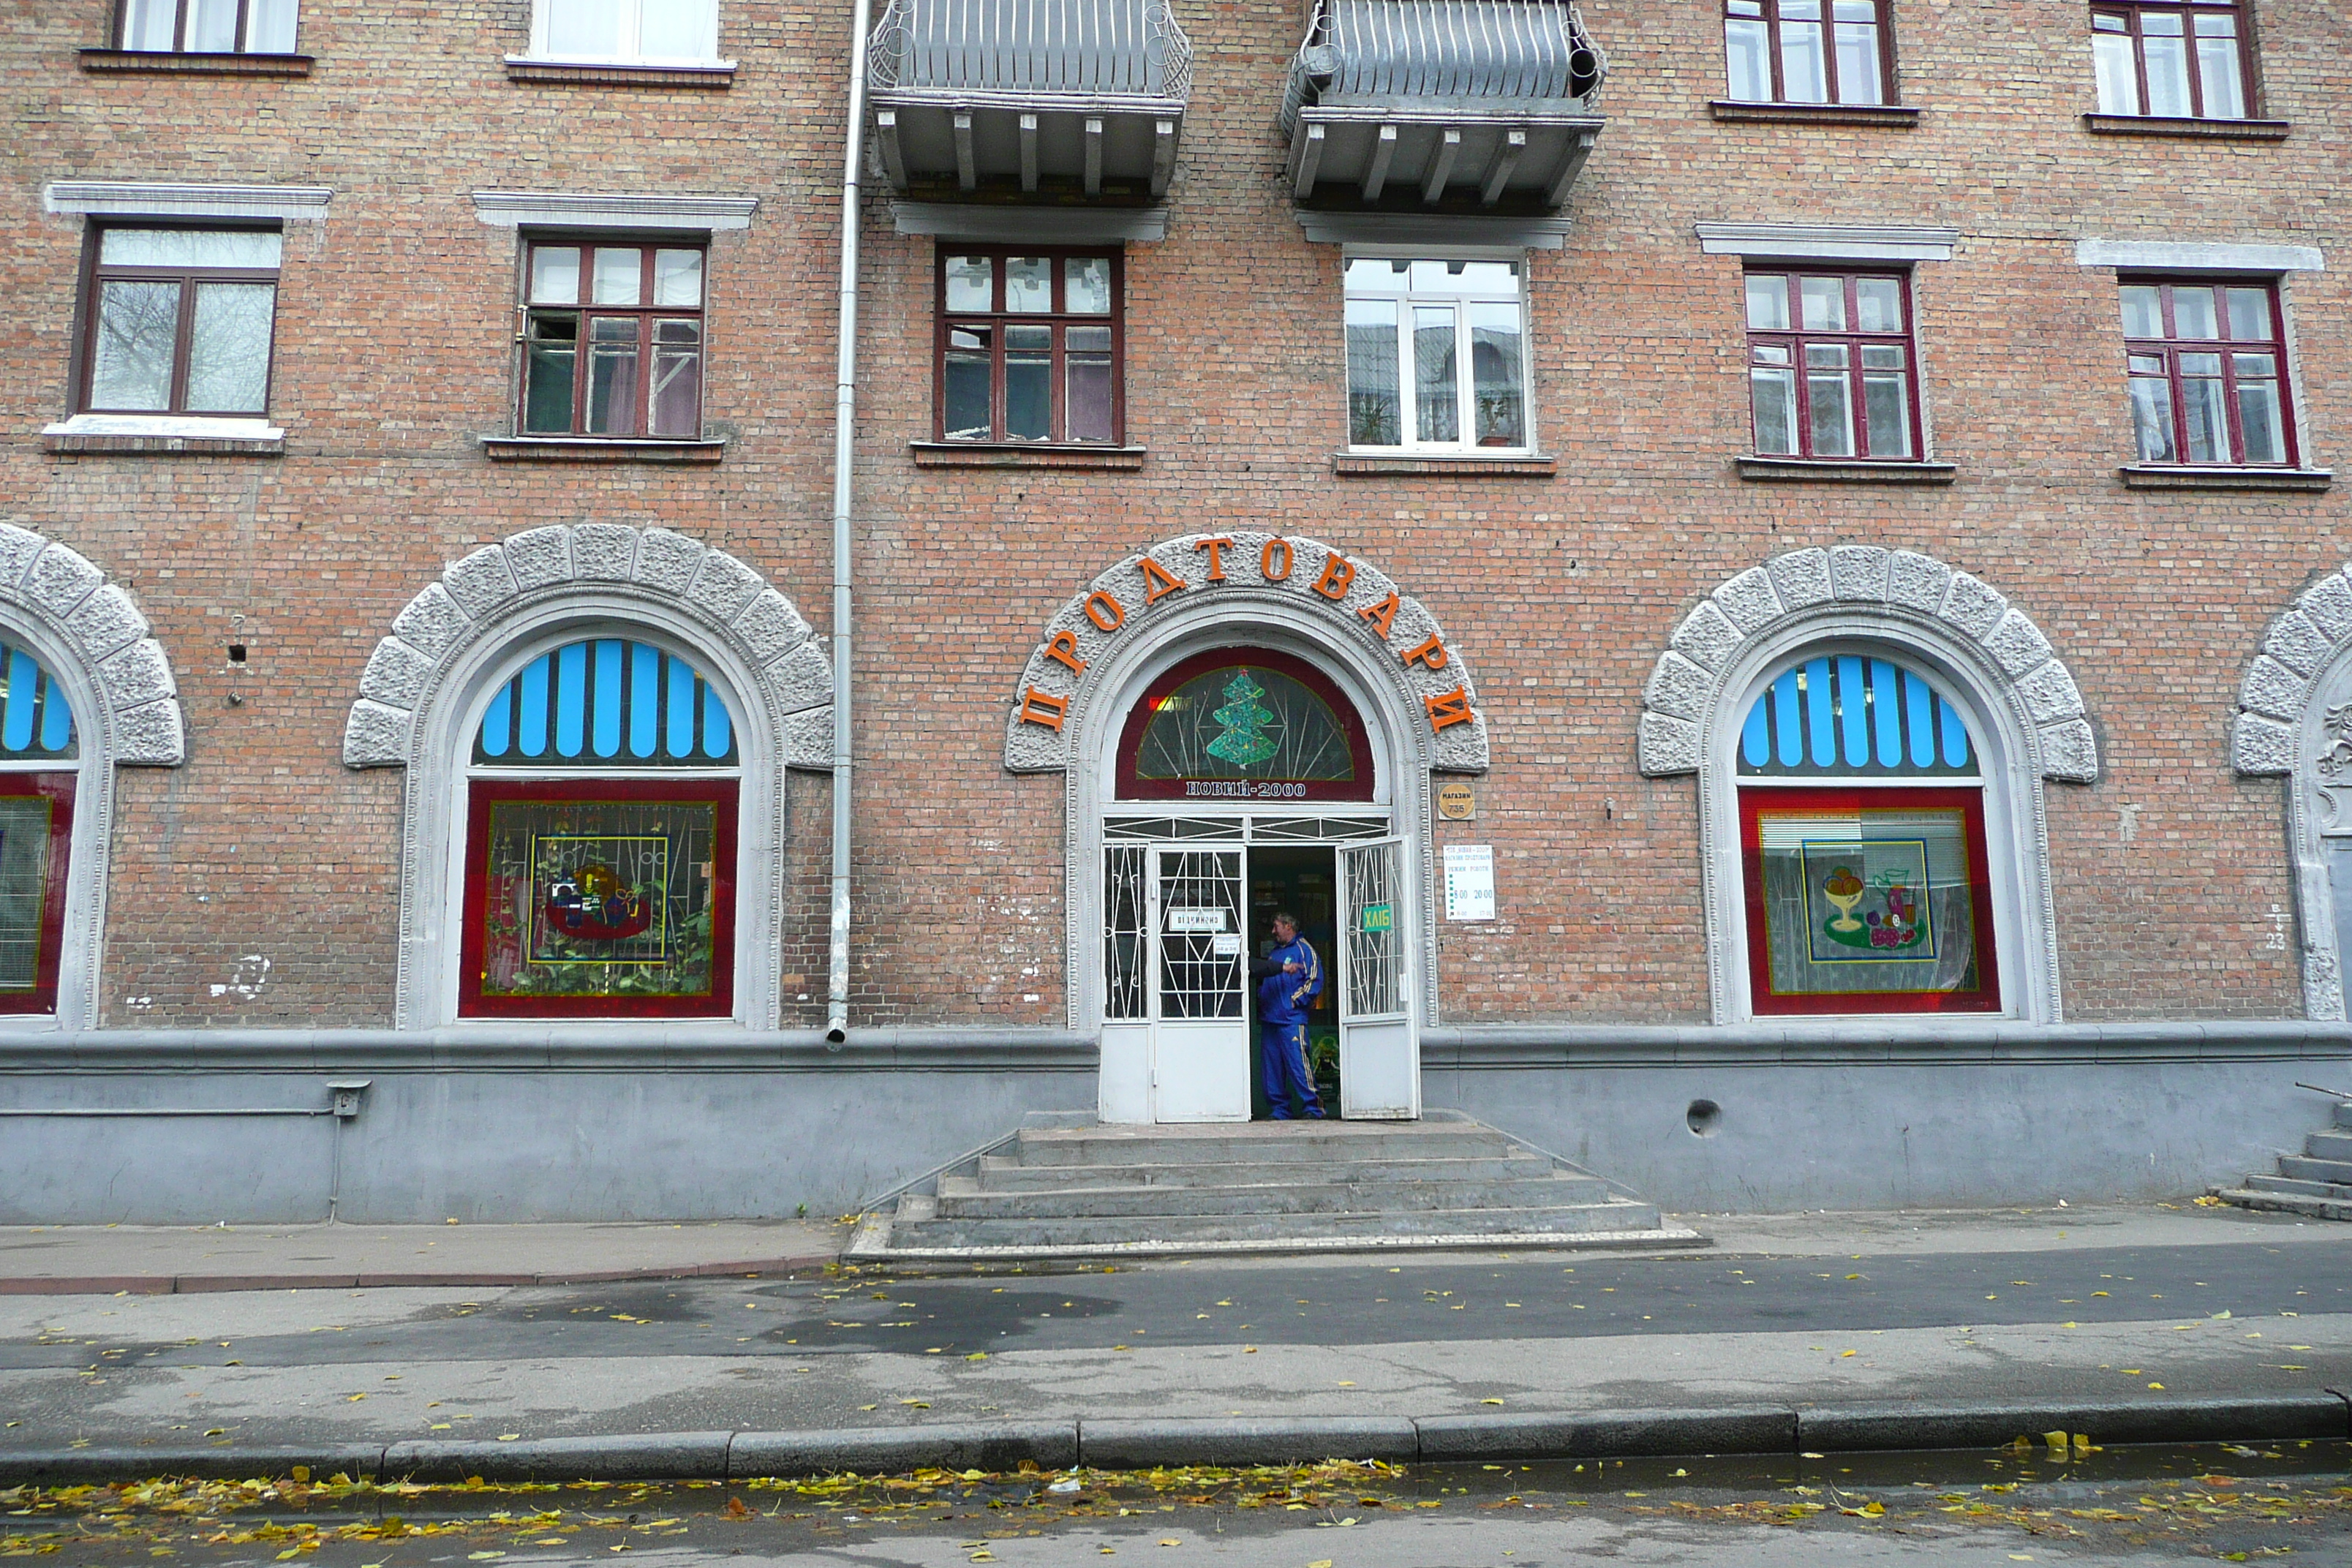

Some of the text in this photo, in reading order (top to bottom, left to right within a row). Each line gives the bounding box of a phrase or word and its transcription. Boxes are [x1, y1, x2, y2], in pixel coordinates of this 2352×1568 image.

[1019, 537, 1474, 733] ПРОДТОВАРИ
[1186, 779, 1306, 797] НОВИЙ-2000
[1449, 804, 1464, 813] 735
[1365, 909, 1390, 928] ХЛІБ
